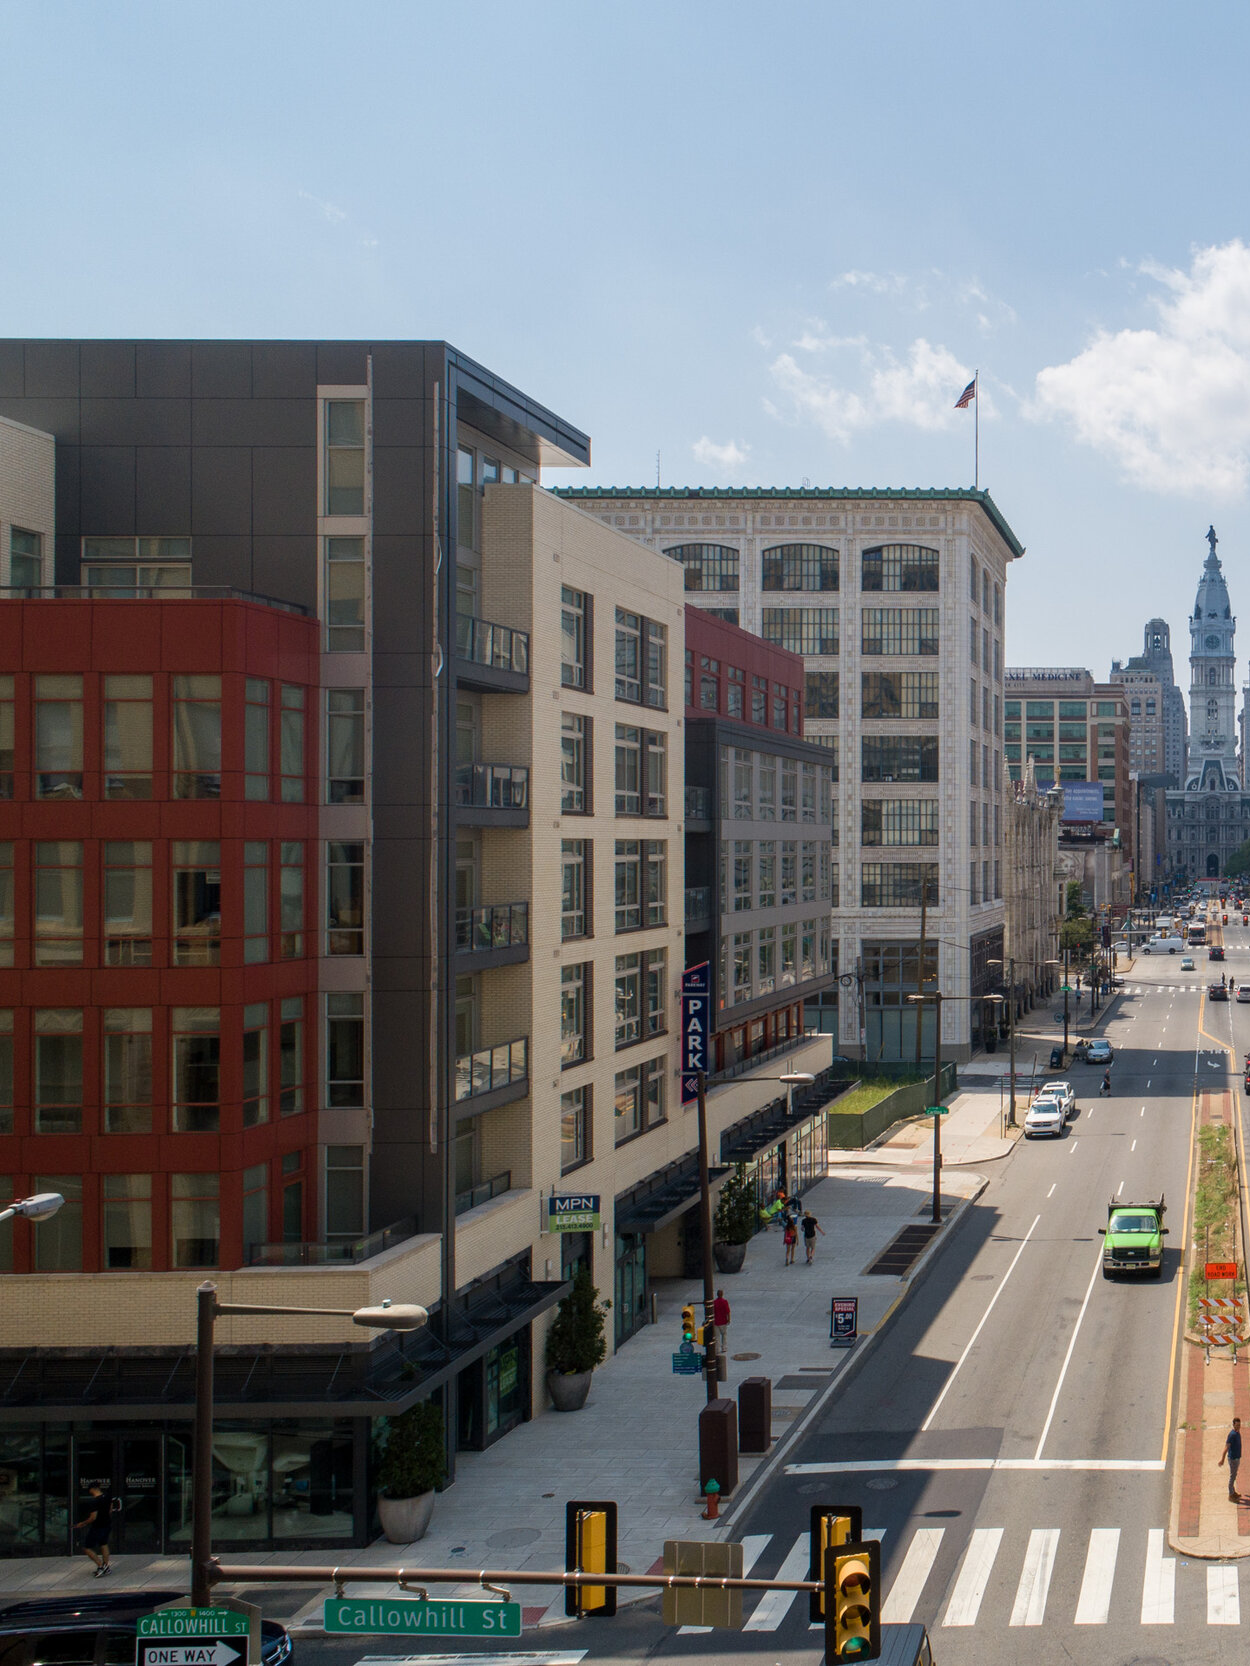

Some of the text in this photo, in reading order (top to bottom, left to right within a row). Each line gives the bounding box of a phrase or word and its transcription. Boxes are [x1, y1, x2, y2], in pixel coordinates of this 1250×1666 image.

[1033, 673, 1081, 681] MEDICINE
[687, 999, 703, 1068] PARK
[555, 1197, 594, 1210] MPN
[556, 1214, 594, 1225] LEASE
[338, 1605, 508, 1630] Callowhill St
[140, 1619, 247, 1635] CALLOWHILL ST
[148, 1649, 216, 1663] ONE WAY
